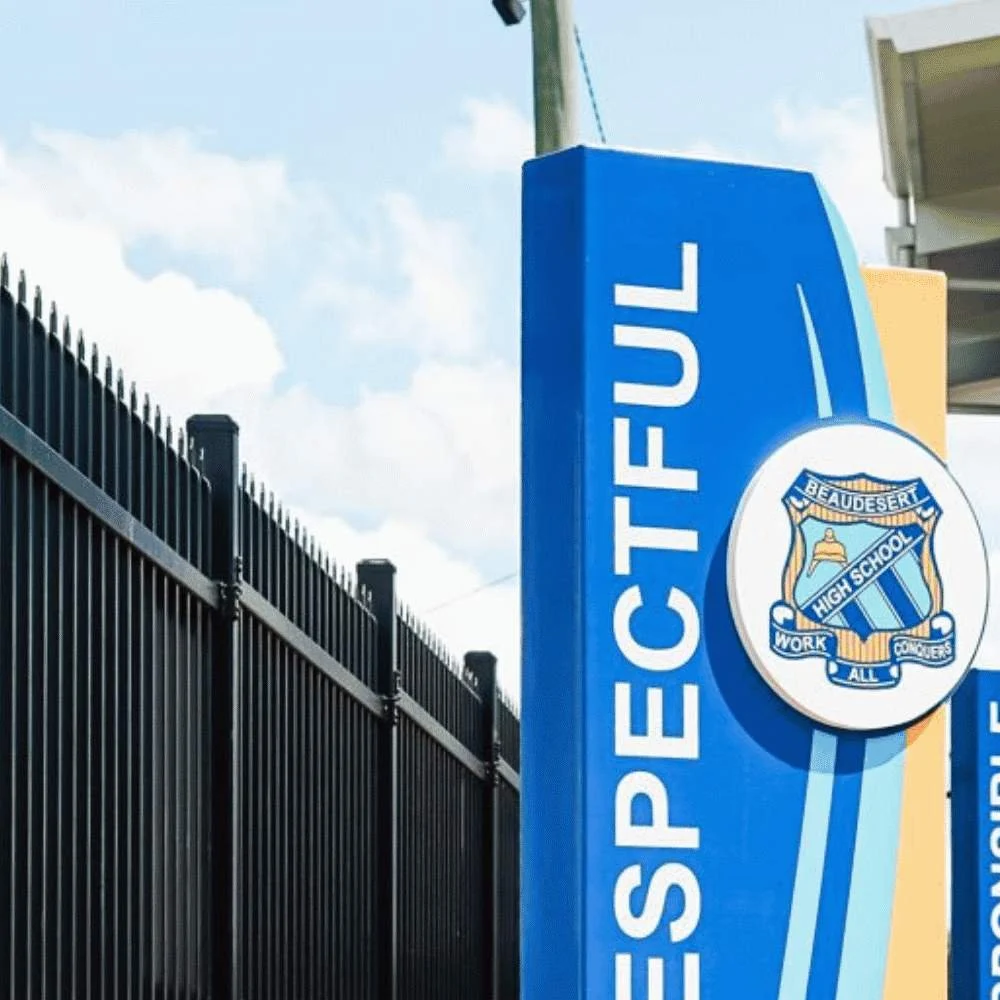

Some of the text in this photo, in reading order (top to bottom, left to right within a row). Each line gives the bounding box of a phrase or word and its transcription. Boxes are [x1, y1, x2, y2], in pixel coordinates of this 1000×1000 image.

[804, 480, 921, 513] BEAUDESERT
[811, 530, 913, 617] HIGH SCHOOL
[774, 633, 827, 652] WORK
[848, 666, 878, 682] ALL
